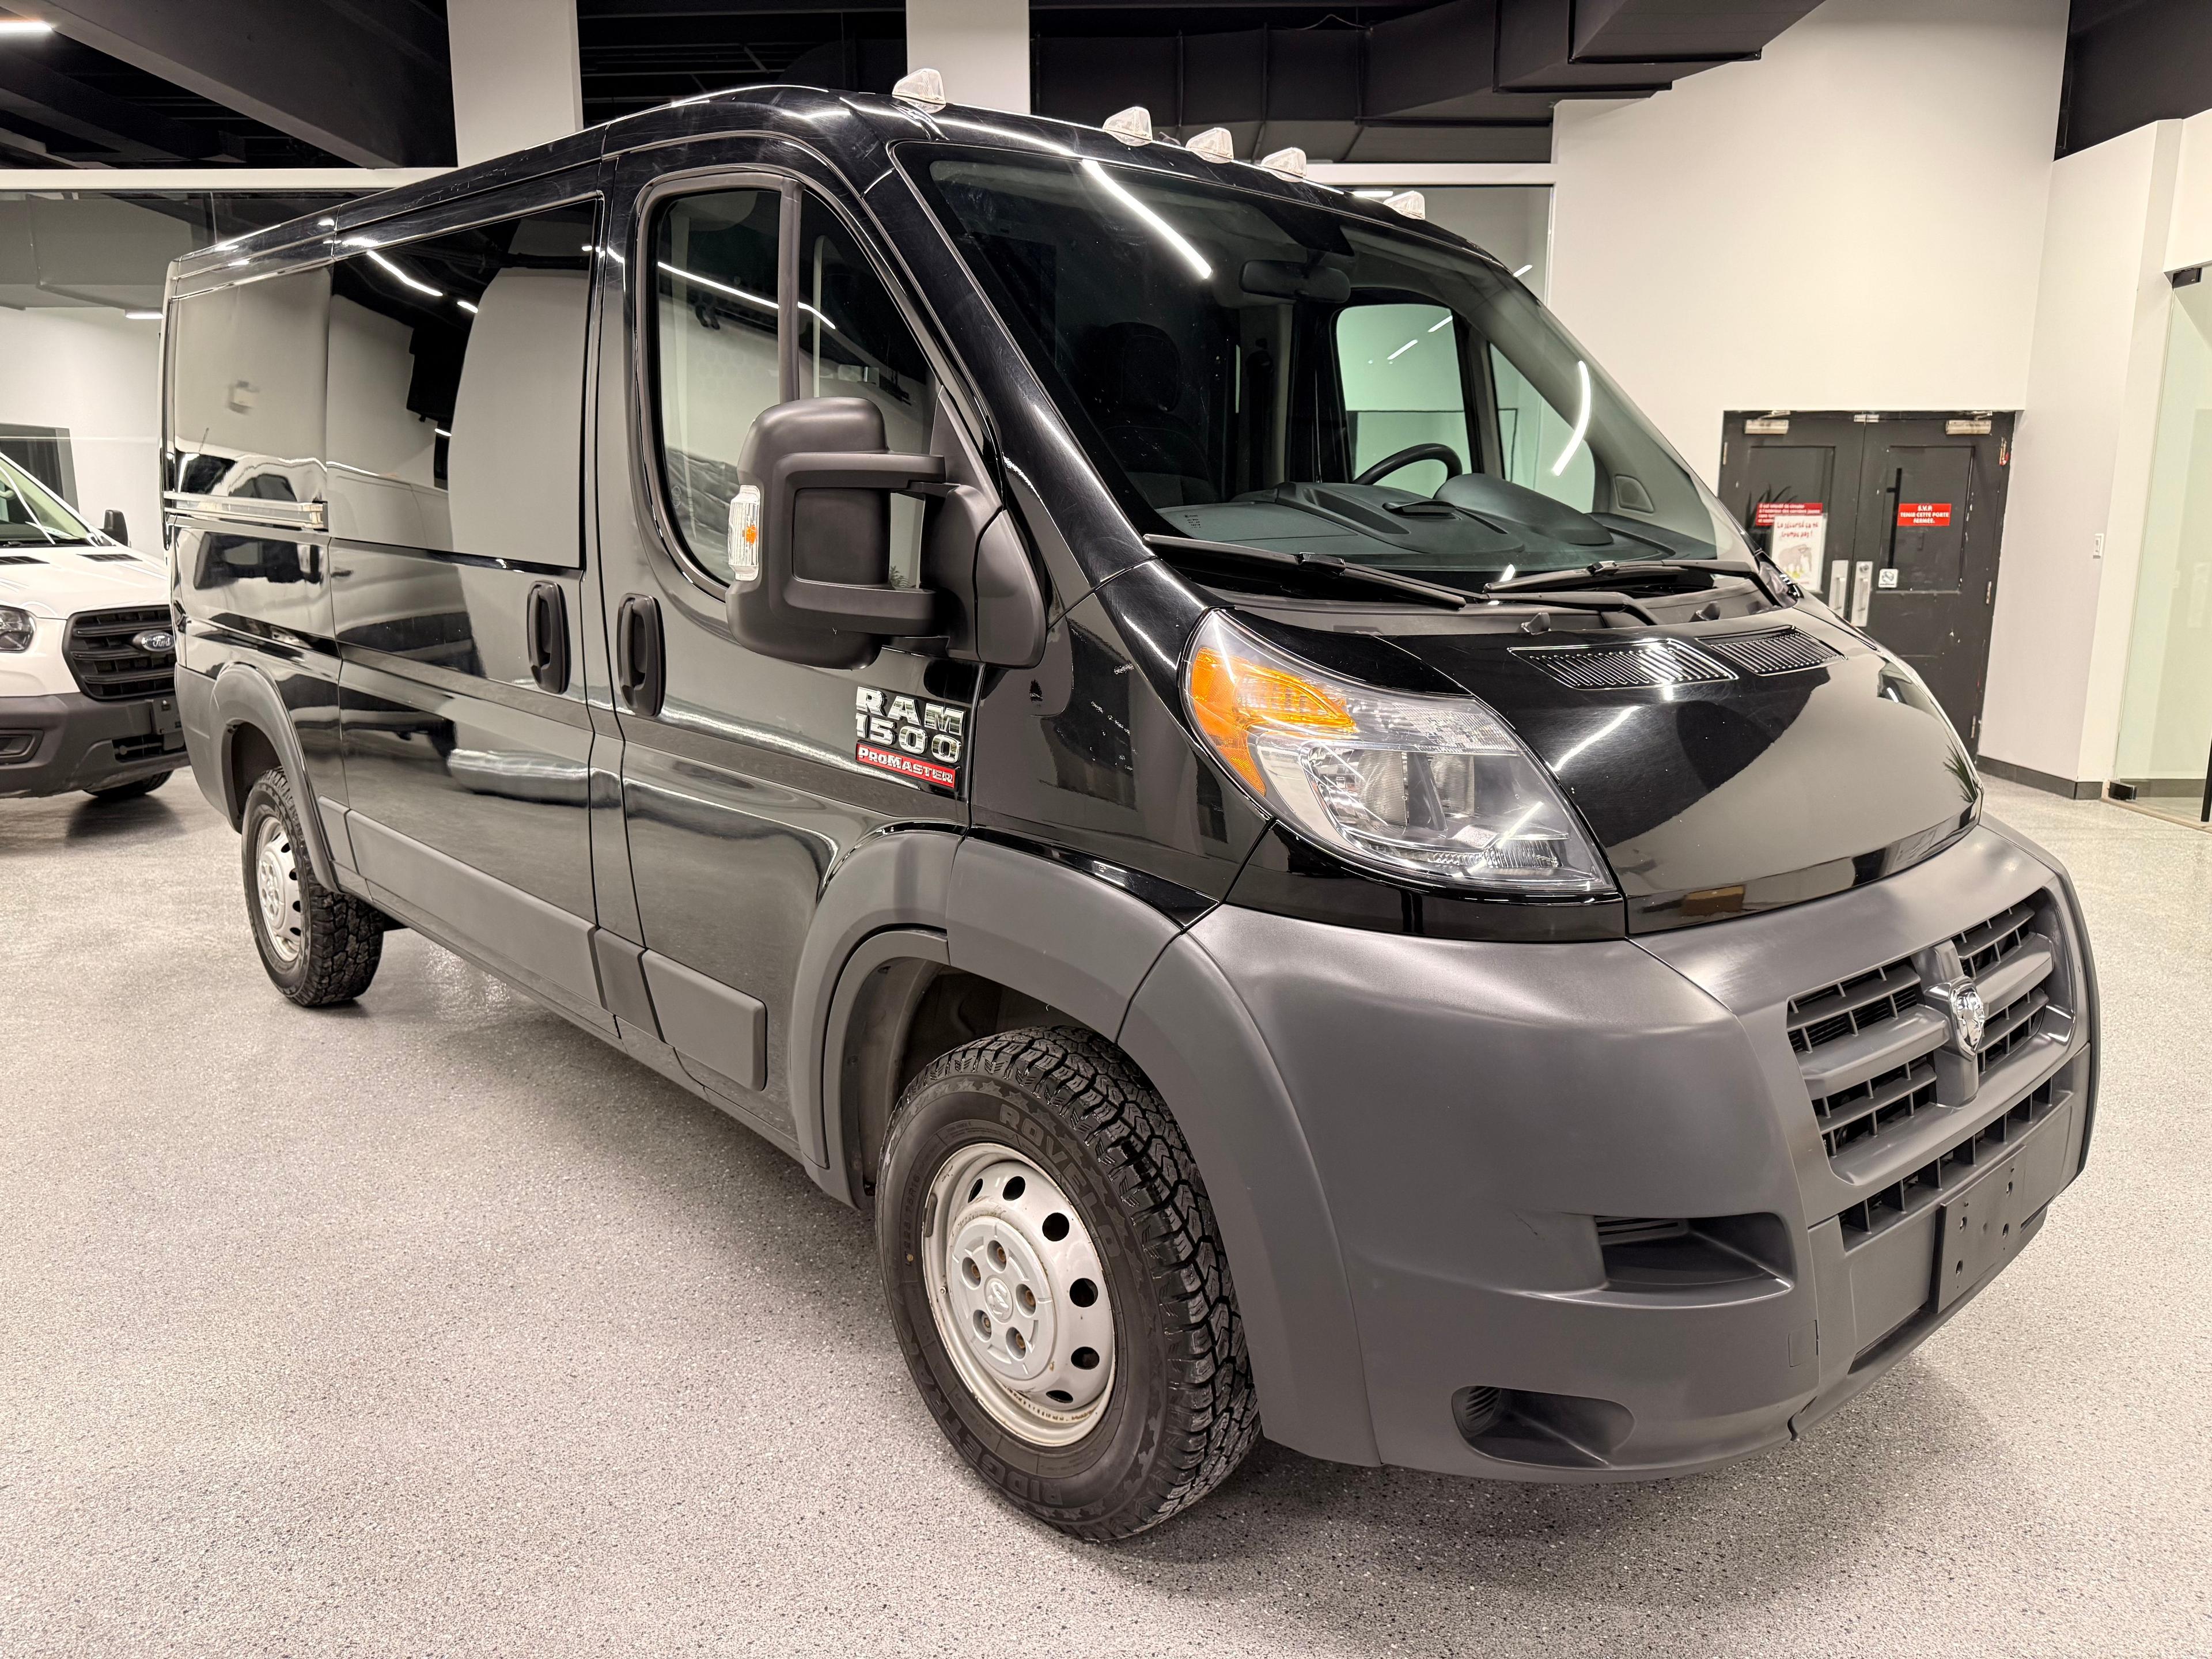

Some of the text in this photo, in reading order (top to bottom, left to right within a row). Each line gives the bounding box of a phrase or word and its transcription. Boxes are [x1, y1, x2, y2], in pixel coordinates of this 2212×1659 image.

[152, 635, 172, 647] Ford
[856, 687, 965, 736] RAM
[855, 713, 963, 763] 1500
[999, 1103, 1122, 1258] ROVELO
